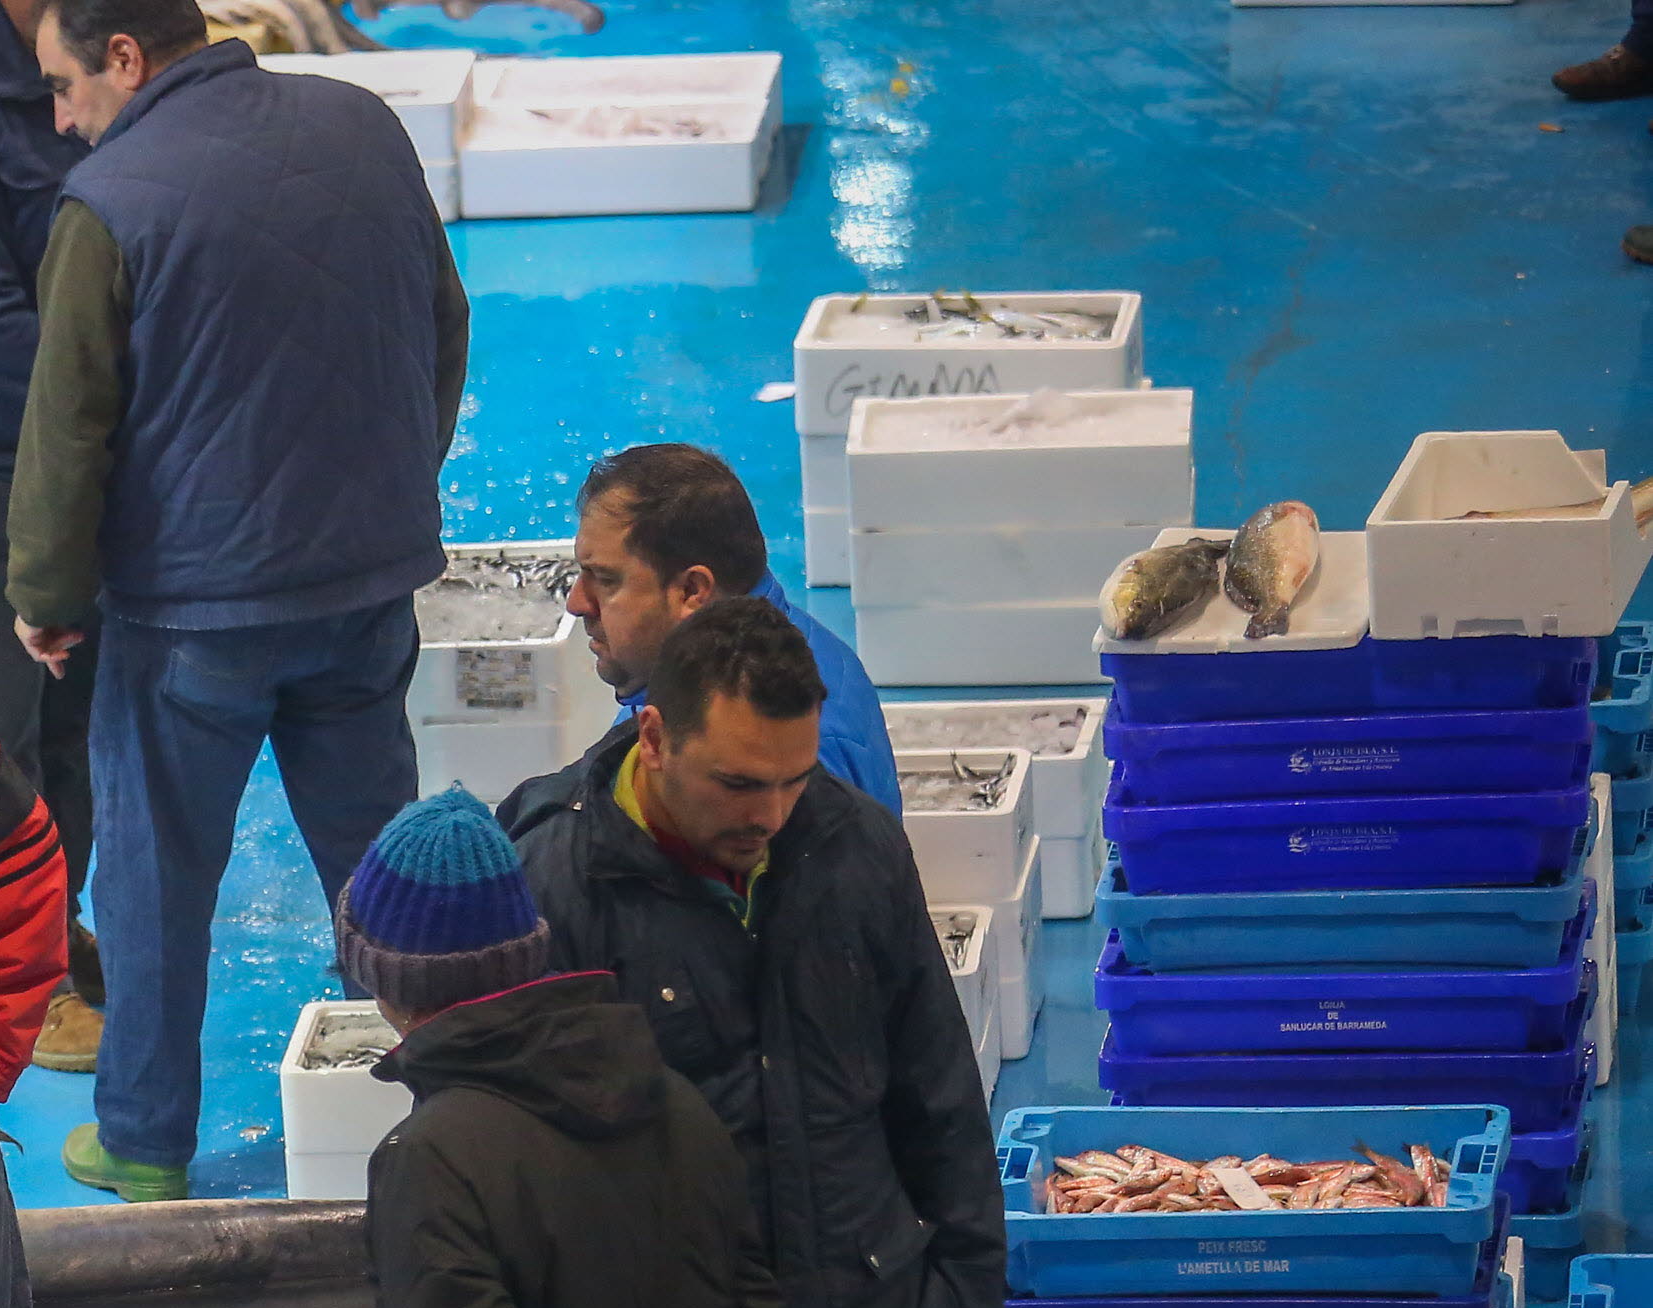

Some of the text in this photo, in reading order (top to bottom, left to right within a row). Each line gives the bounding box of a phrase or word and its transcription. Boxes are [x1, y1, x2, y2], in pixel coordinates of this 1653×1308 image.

[1327, 1012, 1339, 1020] DE
[1280, 1021, 1387, 1032] SANLUCAR DE BARRAMEDA
[1198, 1240, 1267, 1254] PEIX FRESC
[1177, 1260, 1290, 1275] L'AMETLLA DE MAR
